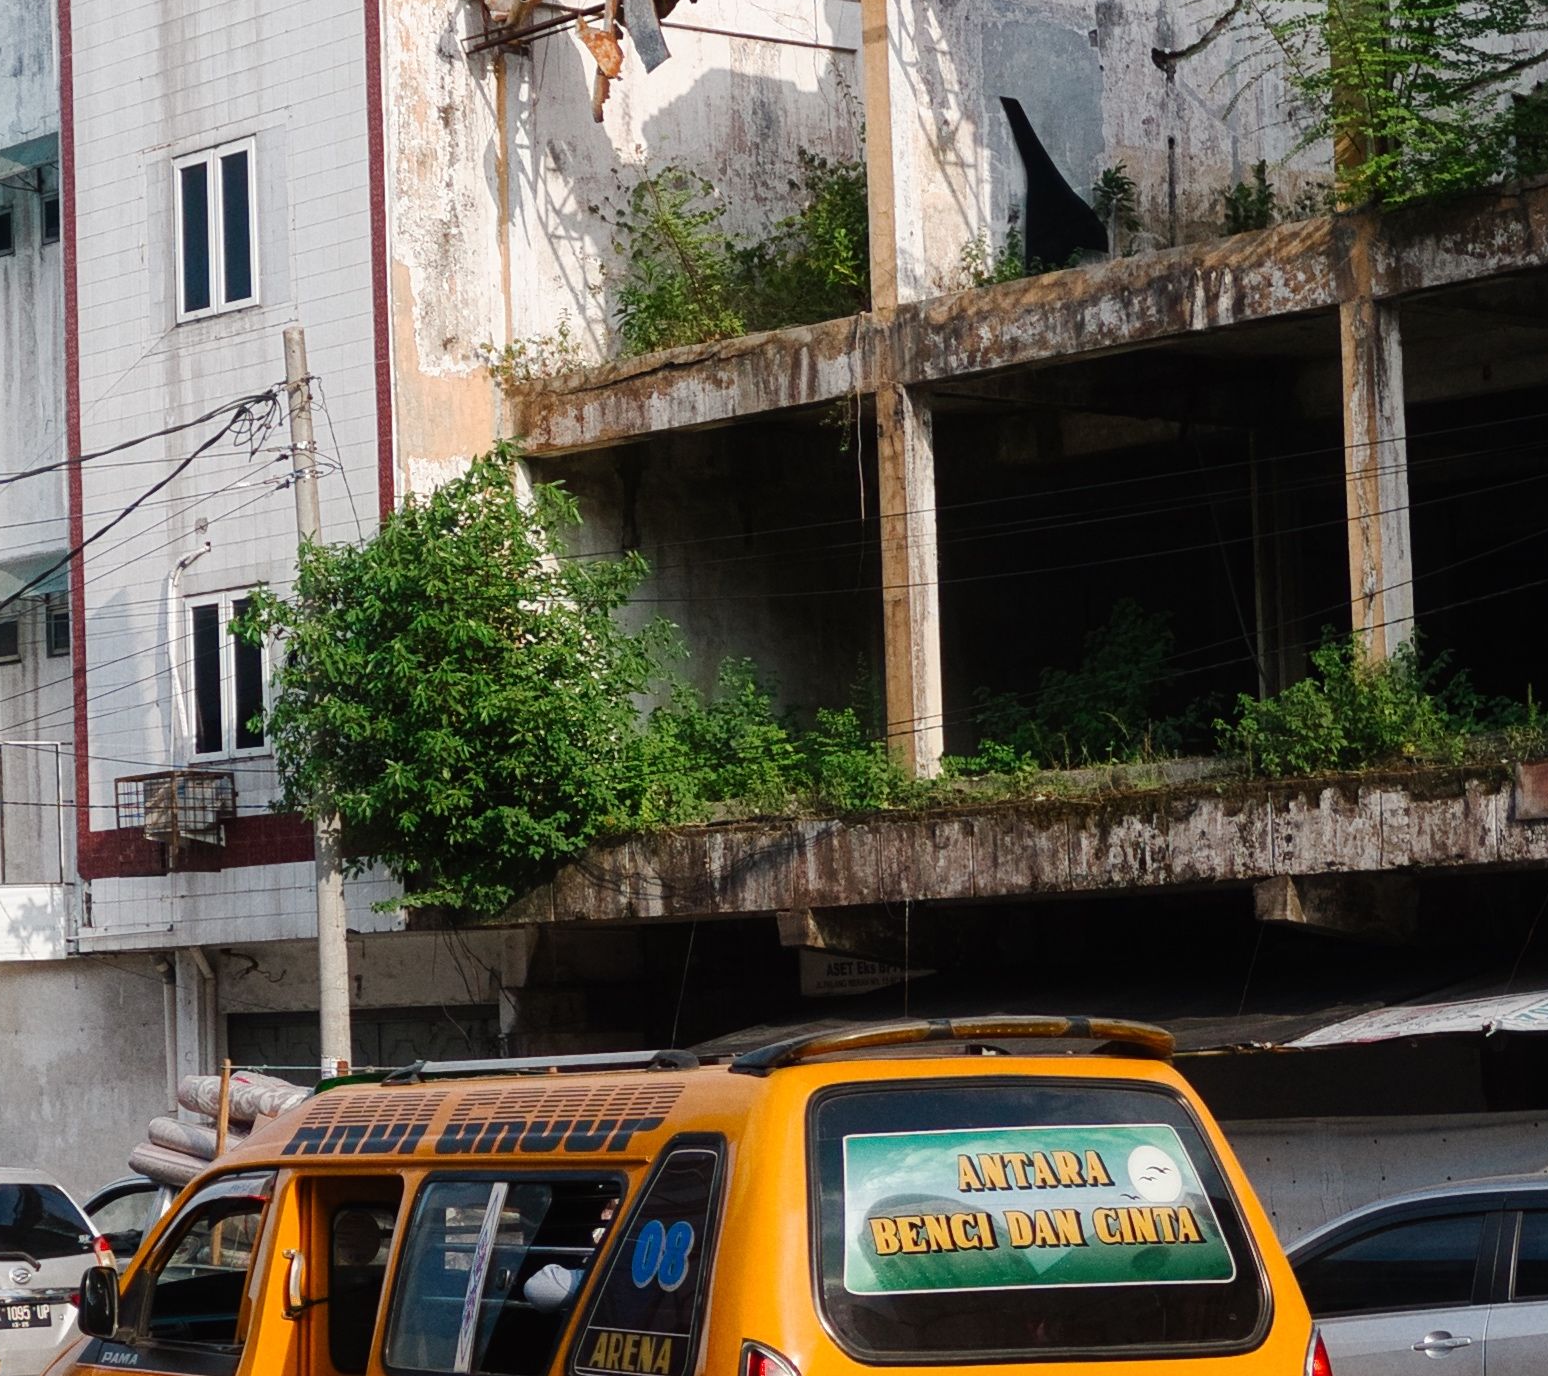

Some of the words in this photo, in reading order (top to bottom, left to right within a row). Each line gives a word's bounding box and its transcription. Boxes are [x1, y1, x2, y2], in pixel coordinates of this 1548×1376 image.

[957, 1149, 1116, 1194] ANTARA
[868, 1210, 999, 1258] BENCI
[1003, 1207, 1090, 1250] DAN
[1091, 1205, 1207, 1247] CINTA
[631, 1218, 695, 1292] 08
[6, 1305, 31, 1321] 1095
[36, 1303, 50, 1320] UP
[101, 1351, 139, 1365] PAMA
[588, 1331, 673, 1375] ARENA
